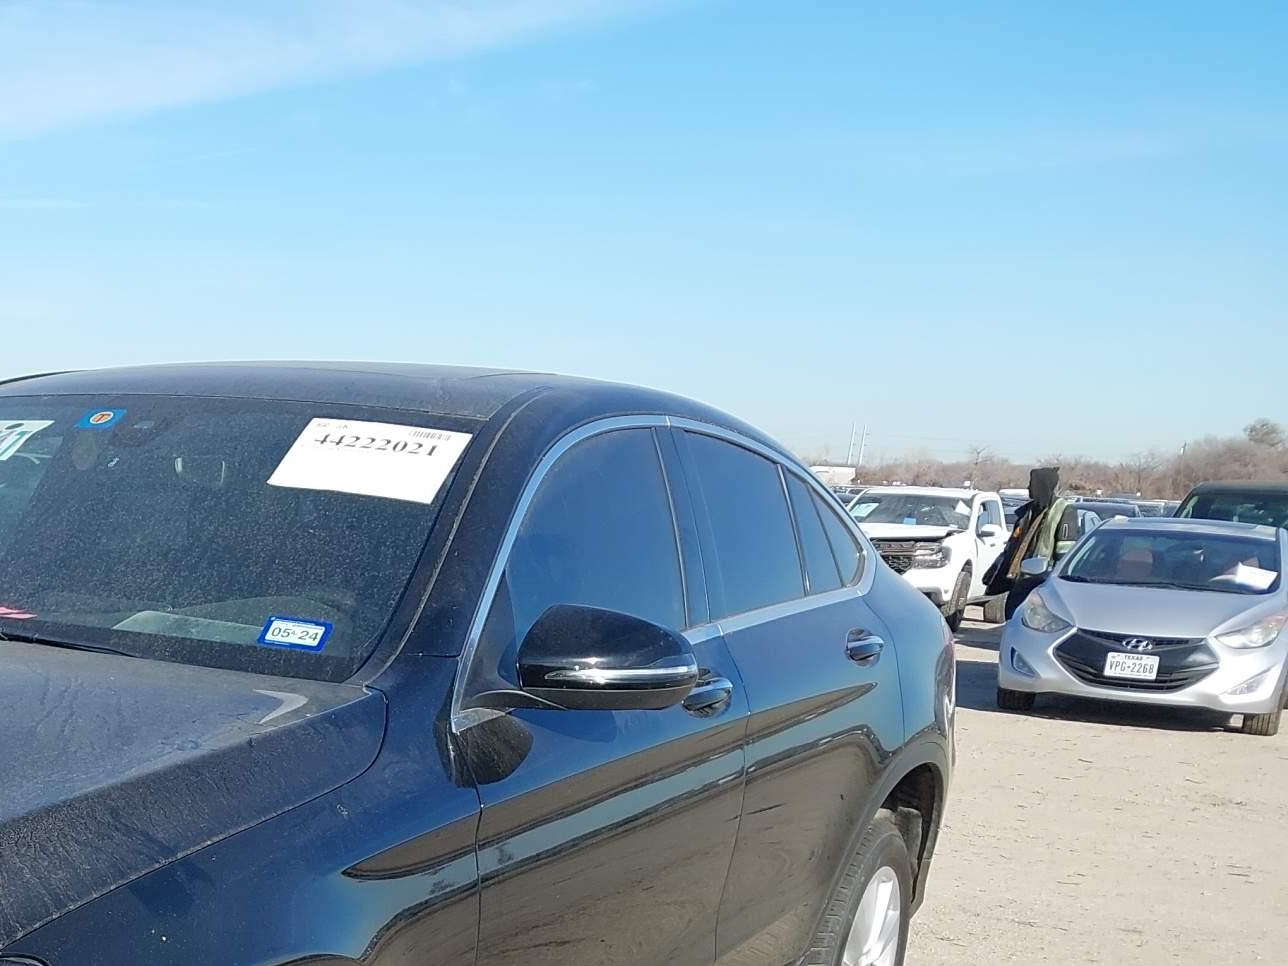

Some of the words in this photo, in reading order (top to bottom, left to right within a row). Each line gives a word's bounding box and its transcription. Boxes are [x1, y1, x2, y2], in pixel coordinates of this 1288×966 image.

[314, 433, 438, 456] 44222021
[271, 626, 293, 638] 05
[298, 630, 319, 641] 24
